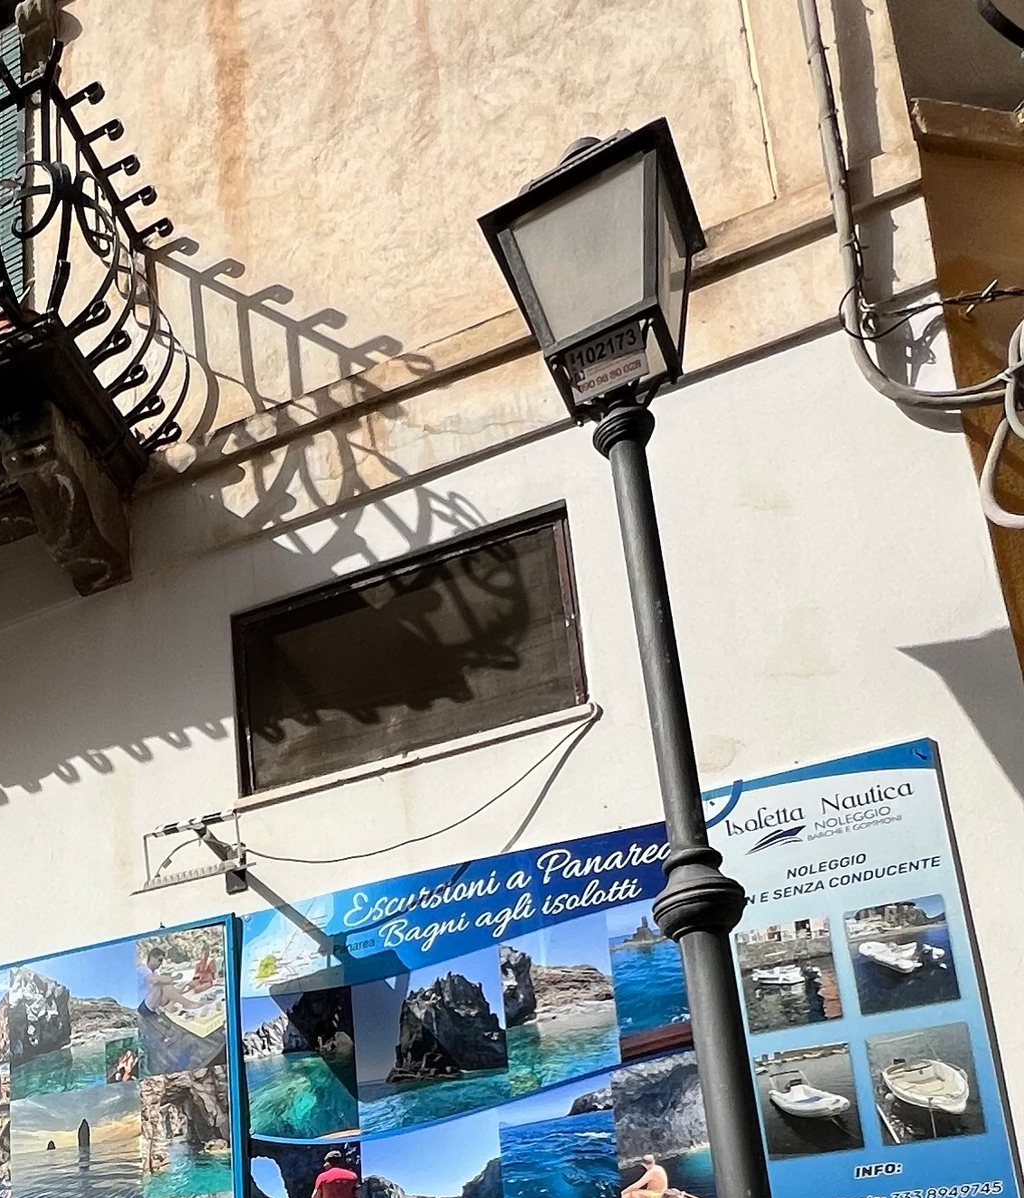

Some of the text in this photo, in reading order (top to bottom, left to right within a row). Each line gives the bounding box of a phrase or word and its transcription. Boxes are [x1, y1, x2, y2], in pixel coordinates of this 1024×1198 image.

[576, 328, 636, 367] 102173
[725, 782, 914, 836] Isoletta Nautica
[815, 806, 891, 830] NOLEGGIO
[853, 815, 902, 831] GOMMONI
[760, 891, 769, 903] E
[773, 880, 824, 901] SENZA
[829, 855, 941, 888] CONDUCENTE
[787, 853, 866, 879] NOLEGGIO
[343, 870, 500, 926] Escursioni
[506, 871, 532, 889] a
[378, 879, 642, 952] Bagni agli isolotti
[854, 1162, 903, 1180] INFO:
